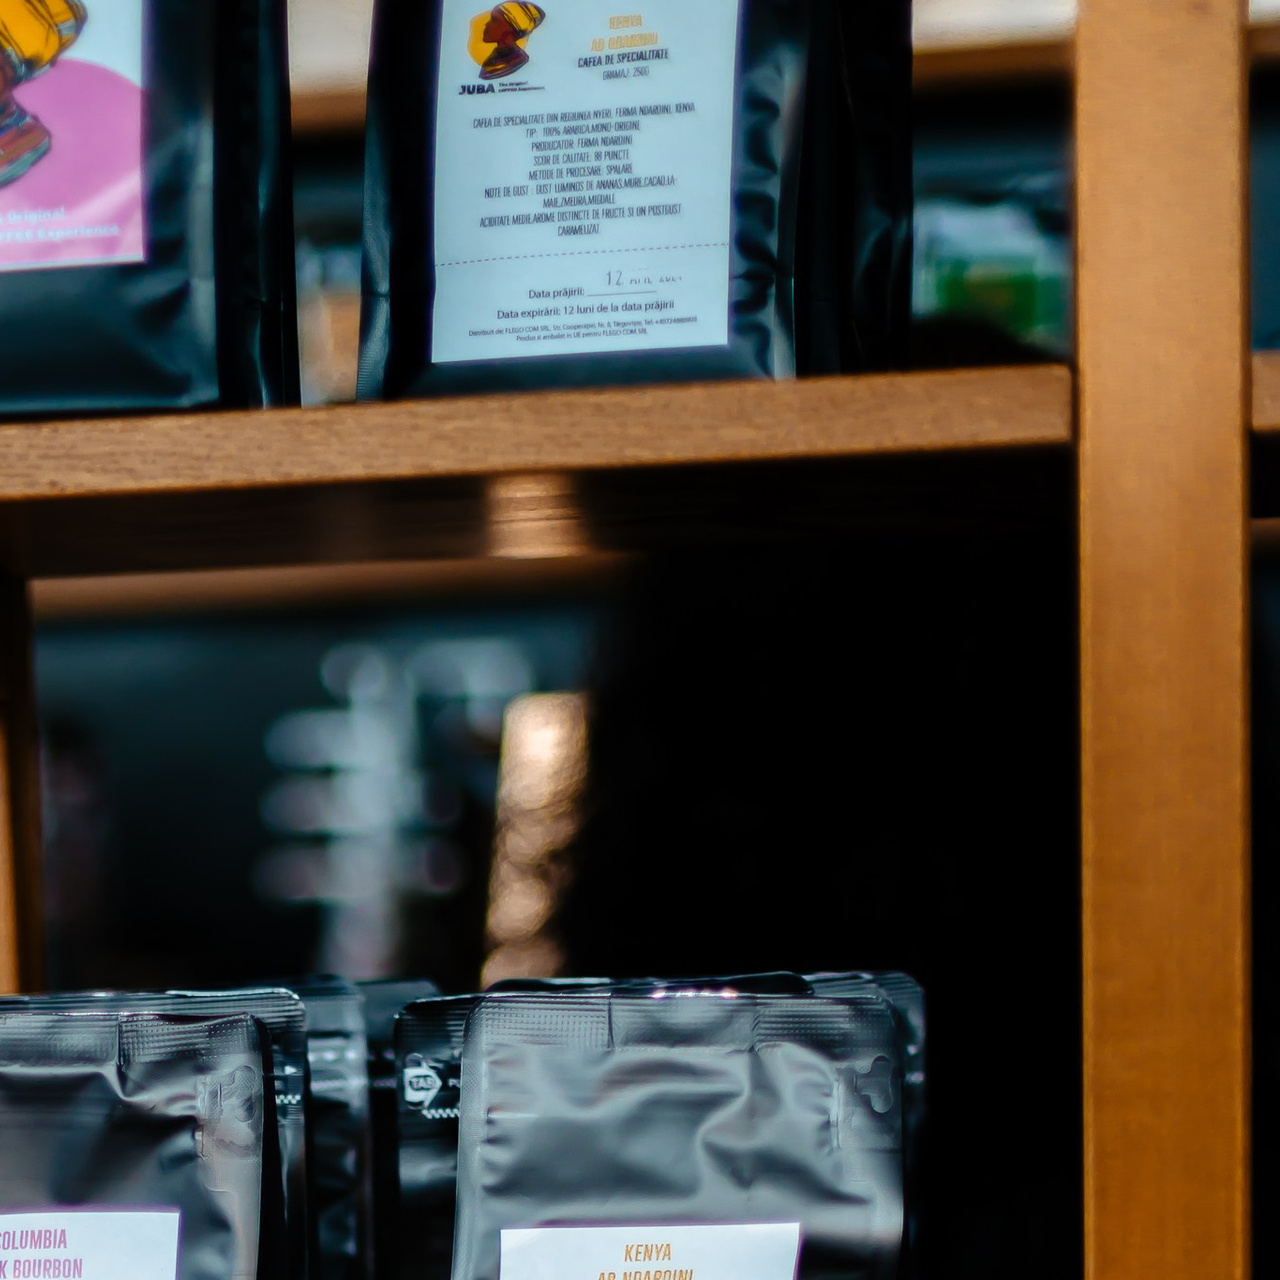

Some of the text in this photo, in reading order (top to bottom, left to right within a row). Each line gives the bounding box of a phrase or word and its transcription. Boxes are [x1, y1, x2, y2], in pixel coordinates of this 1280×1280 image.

[577, 48, 669, 69] CAFEA DE SPECIALITATE
[458, 83, 496, 96] JUBA
[493, 116, 502, 128] DE
[503, 113, 545, 127] SPECIALITATE
[546, 112, 559, 123] DIN
[615, 105, 638, 118] FERMA
[542, 125, 561, 137] 100%
[577, 136, 599, 149] FERMA
[533, 154, 551, 167] SCOR
[552, 153, 560, 165] DE
[604, 148, 629, 161] PUNCTE
[528, 168, 554, 181] METODE
[555, 167, 564, 179] DE
[484, 187, 501, 199] NOTE
[503, 186, 511, 198] DE
[512, 184, 529, 197] GUST
[554, 180, 585, 194] LUMINOS
[586, 180, 594, 192] DE
[479, 214, 510, 228] ACIDITATE
[557, 209, 590, 222] DISTINCTE
[592, 208, 600, 220] DE
[601, 206, 626, 219] FRUCTE
[636, 205, 646, 217] UN
[647, 203, 682, 216] POSTGUST
[528, 289, 551, 300] Data
[606, 269, 624, 286] 12
[496, 309, 519, 320] Data
[563, 306, 575, 315] 12
[576, 303, 594, 315] luni
[596, 303, 609, 313] de
[610, 302, 619, 313] la
[621, 301, 642, 312] data
[623, 1243, 672, 1262] KENYA
[12, 1258, 83, 1280] BOURBON
